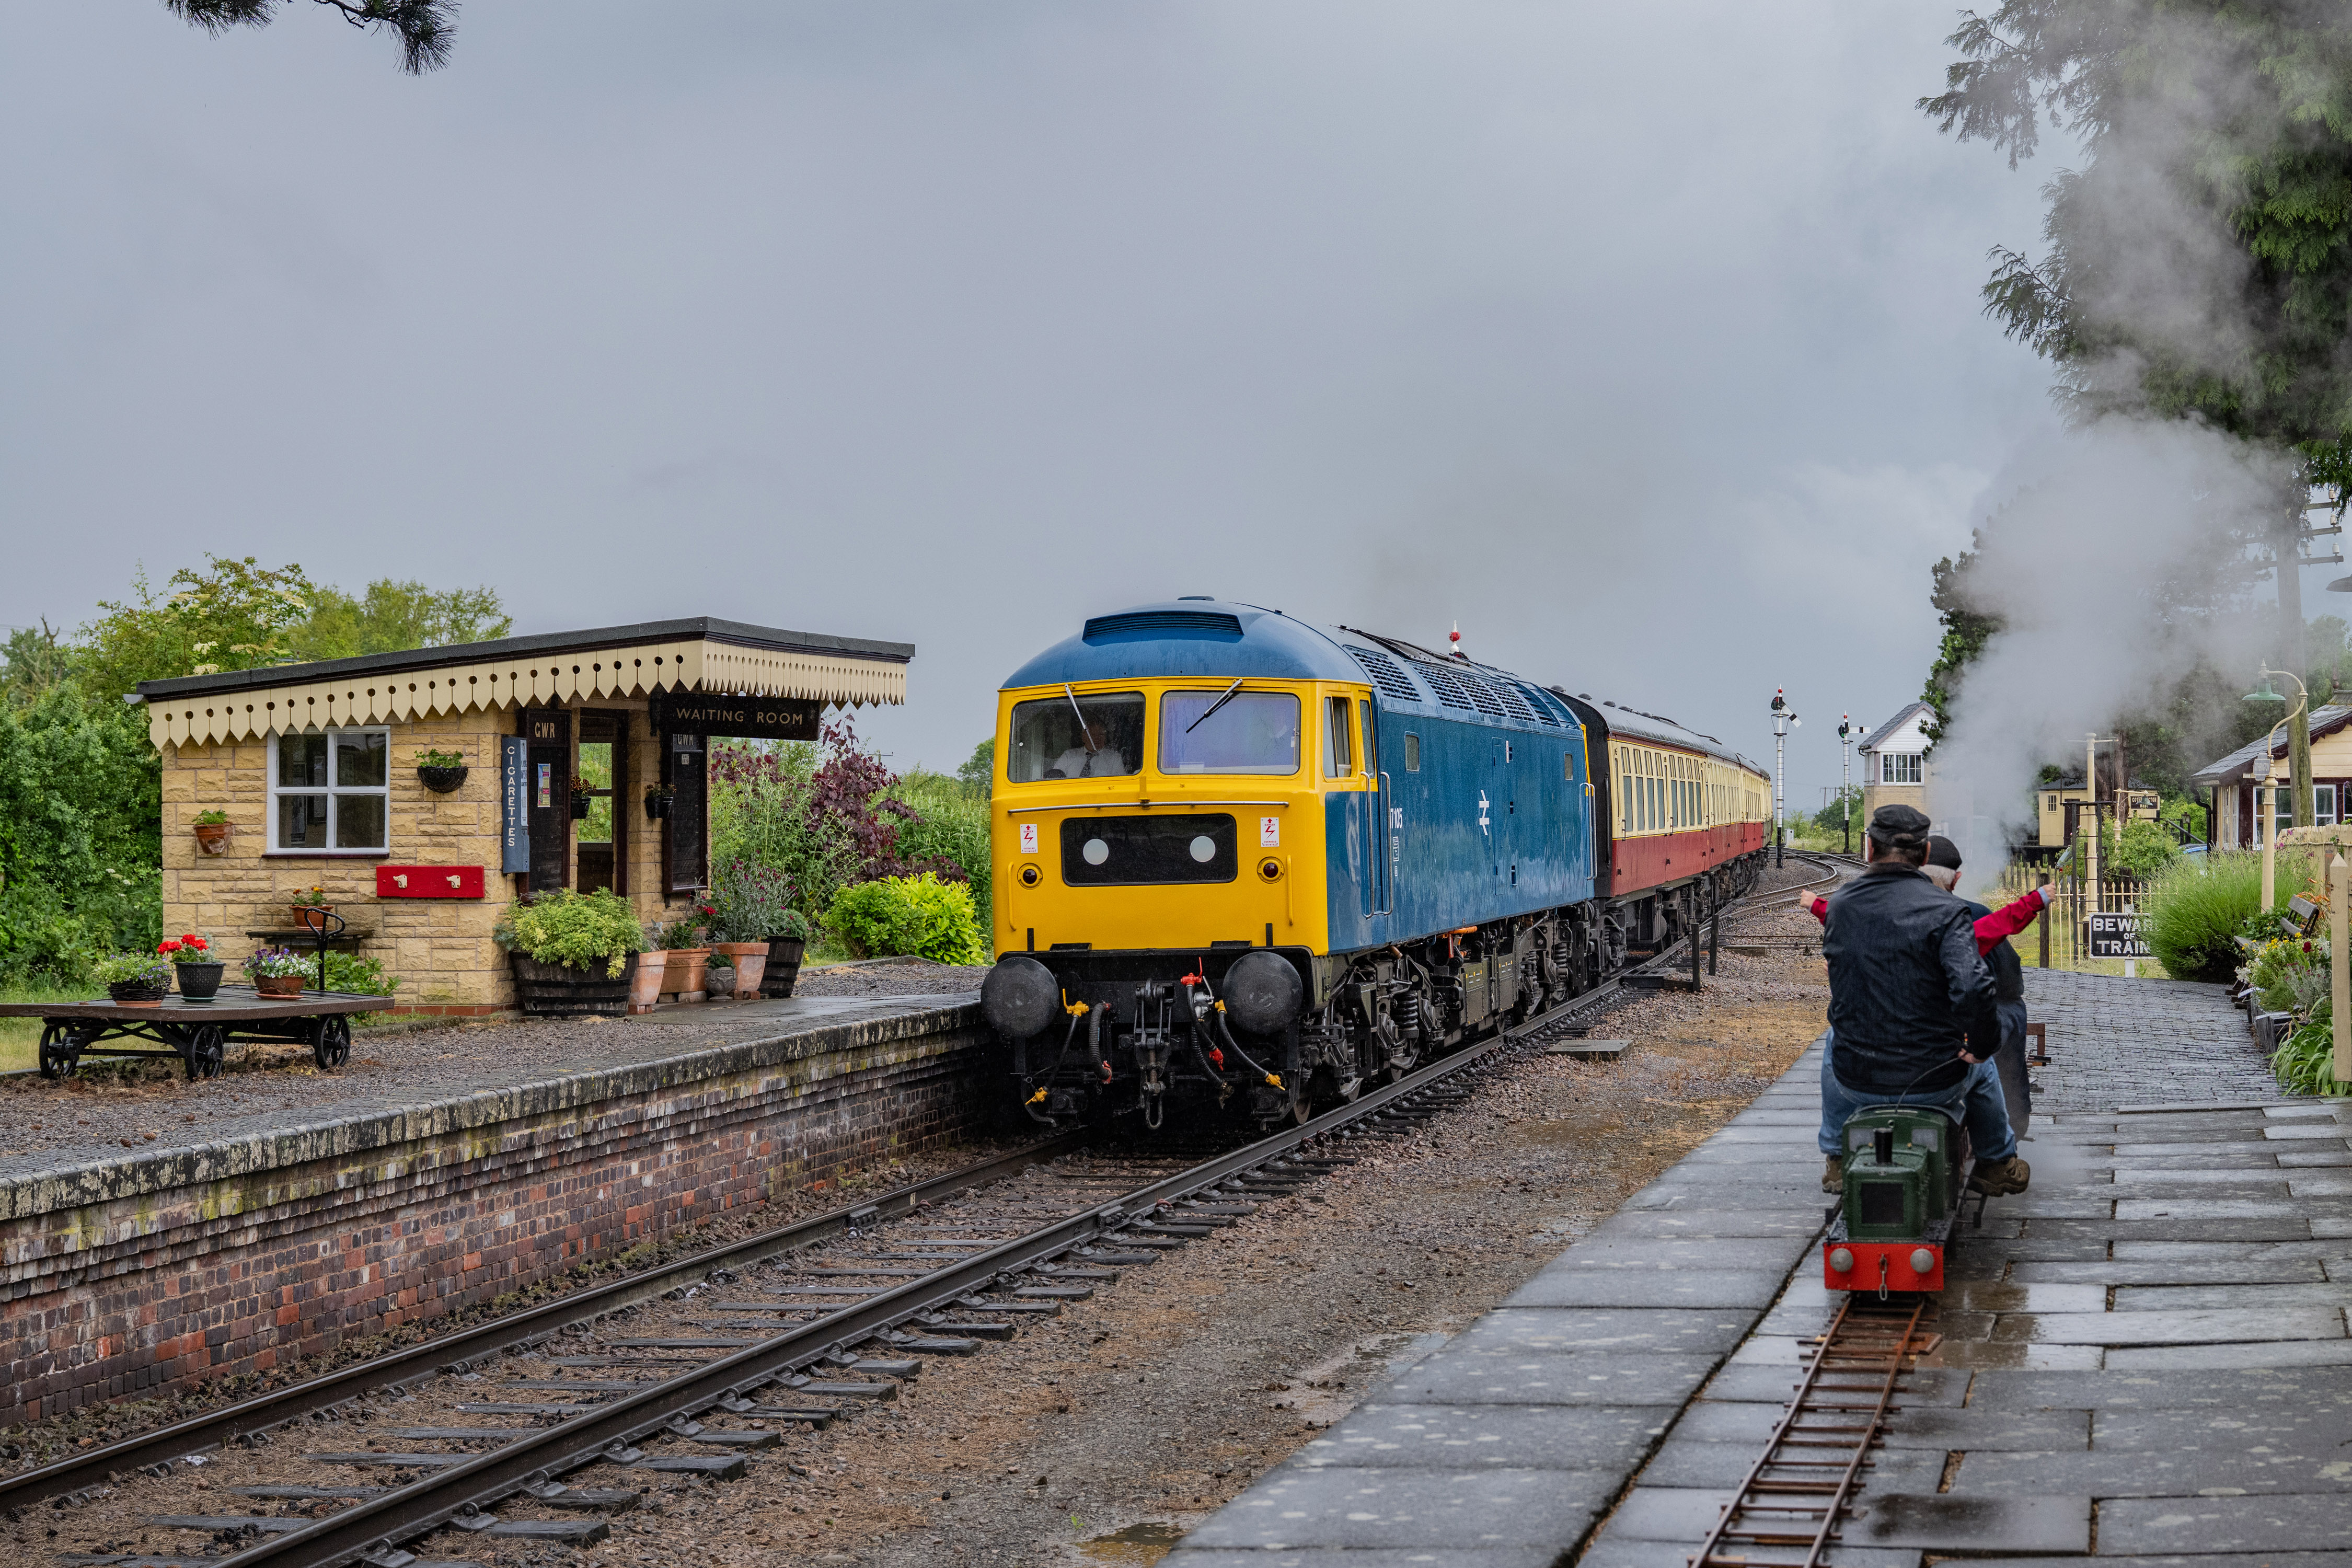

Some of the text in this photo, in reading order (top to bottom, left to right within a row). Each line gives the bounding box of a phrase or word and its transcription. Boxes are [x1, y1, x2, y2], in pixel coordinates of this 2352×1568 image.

[676, 708, 802, 725] WAITING ROOM
[535, 722, 555, 738] GWR
[677, 734, 693, 746] GWR
[507, 746, 516, 846] CIGARETTES
[1390, 808, 1403, 829] 7105
[2093, 918, 2154, 931] BEWAR
[2096, 940, 2151, 954] TRAIN
